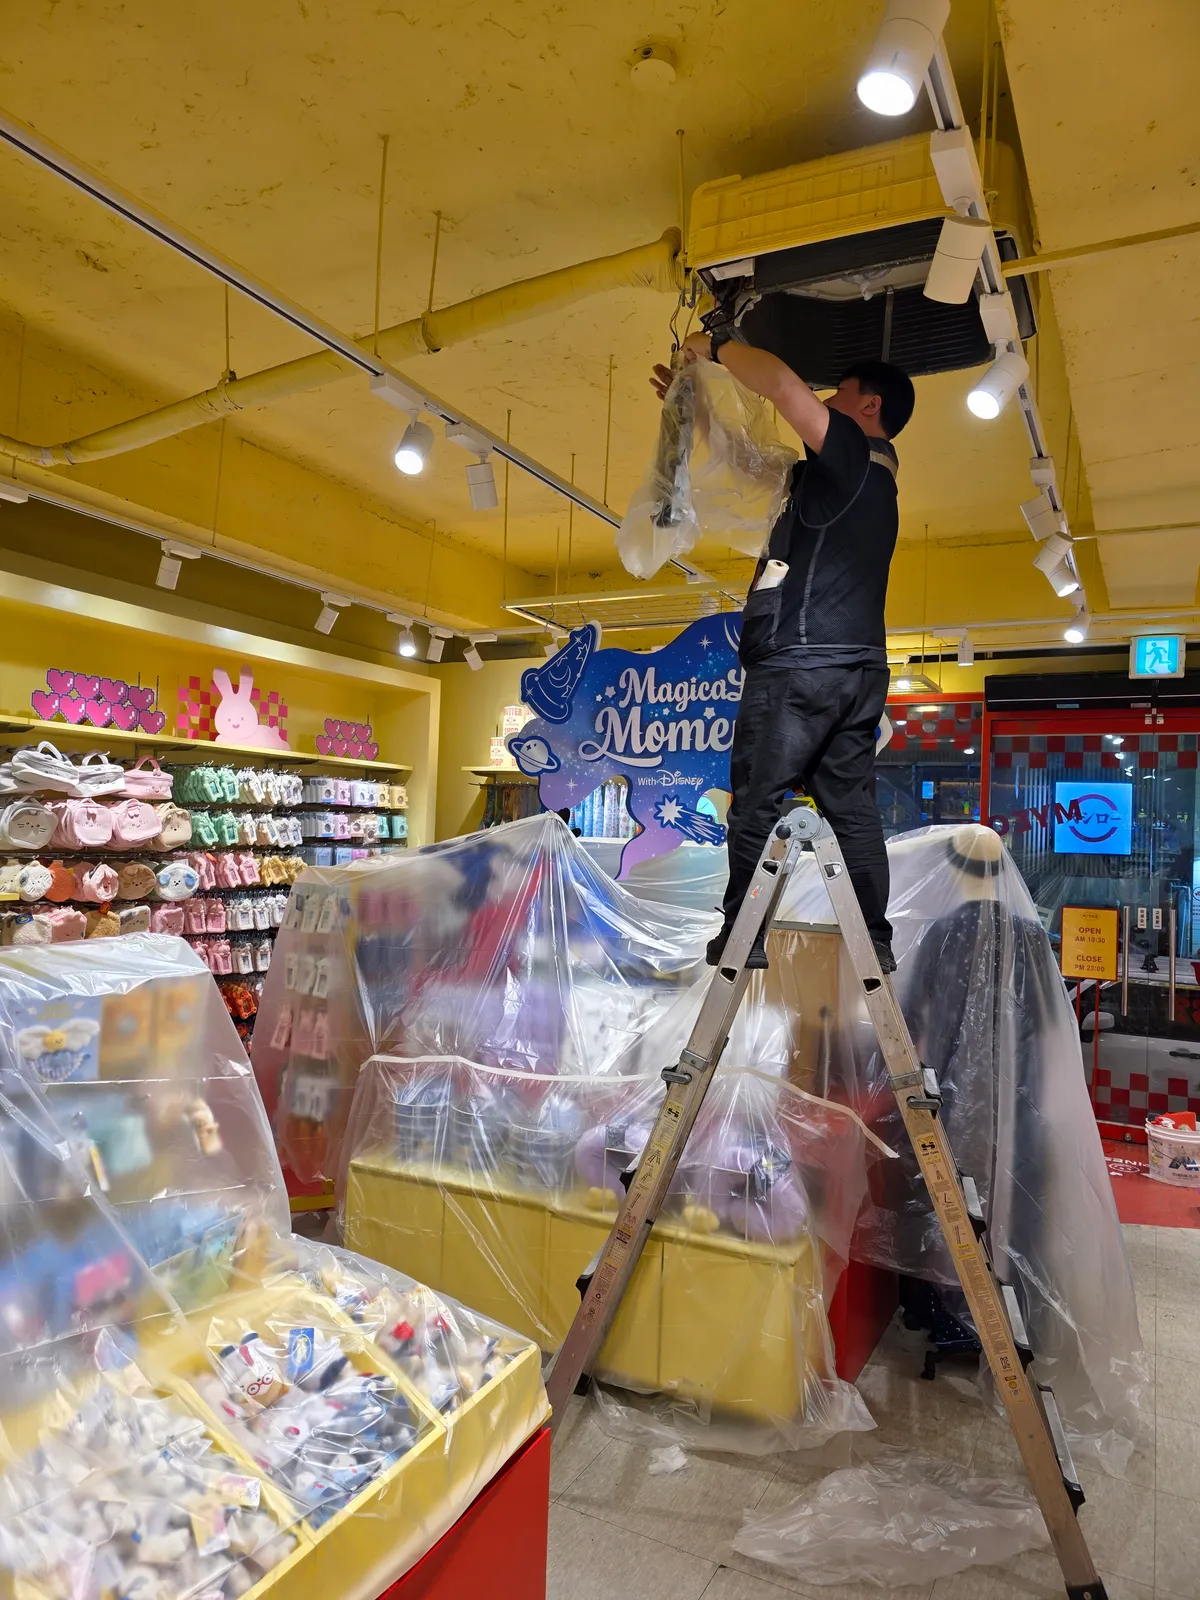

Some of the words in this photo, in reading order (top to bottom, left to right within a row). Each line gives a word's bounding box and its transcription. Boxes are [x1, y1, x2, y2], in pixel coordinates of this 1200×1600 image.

[578, 706, 737, 768] Mome
[637, 776, 657, 787] With
[656, 769, 704, 791] Disney
[1078, 926, 1102, 935] OPEN
[1088, 936, 1106, 944] 10:30
[1076, 954, 1103, 963] CLOSE
[1086, 964, 1106, 973] 23:00
